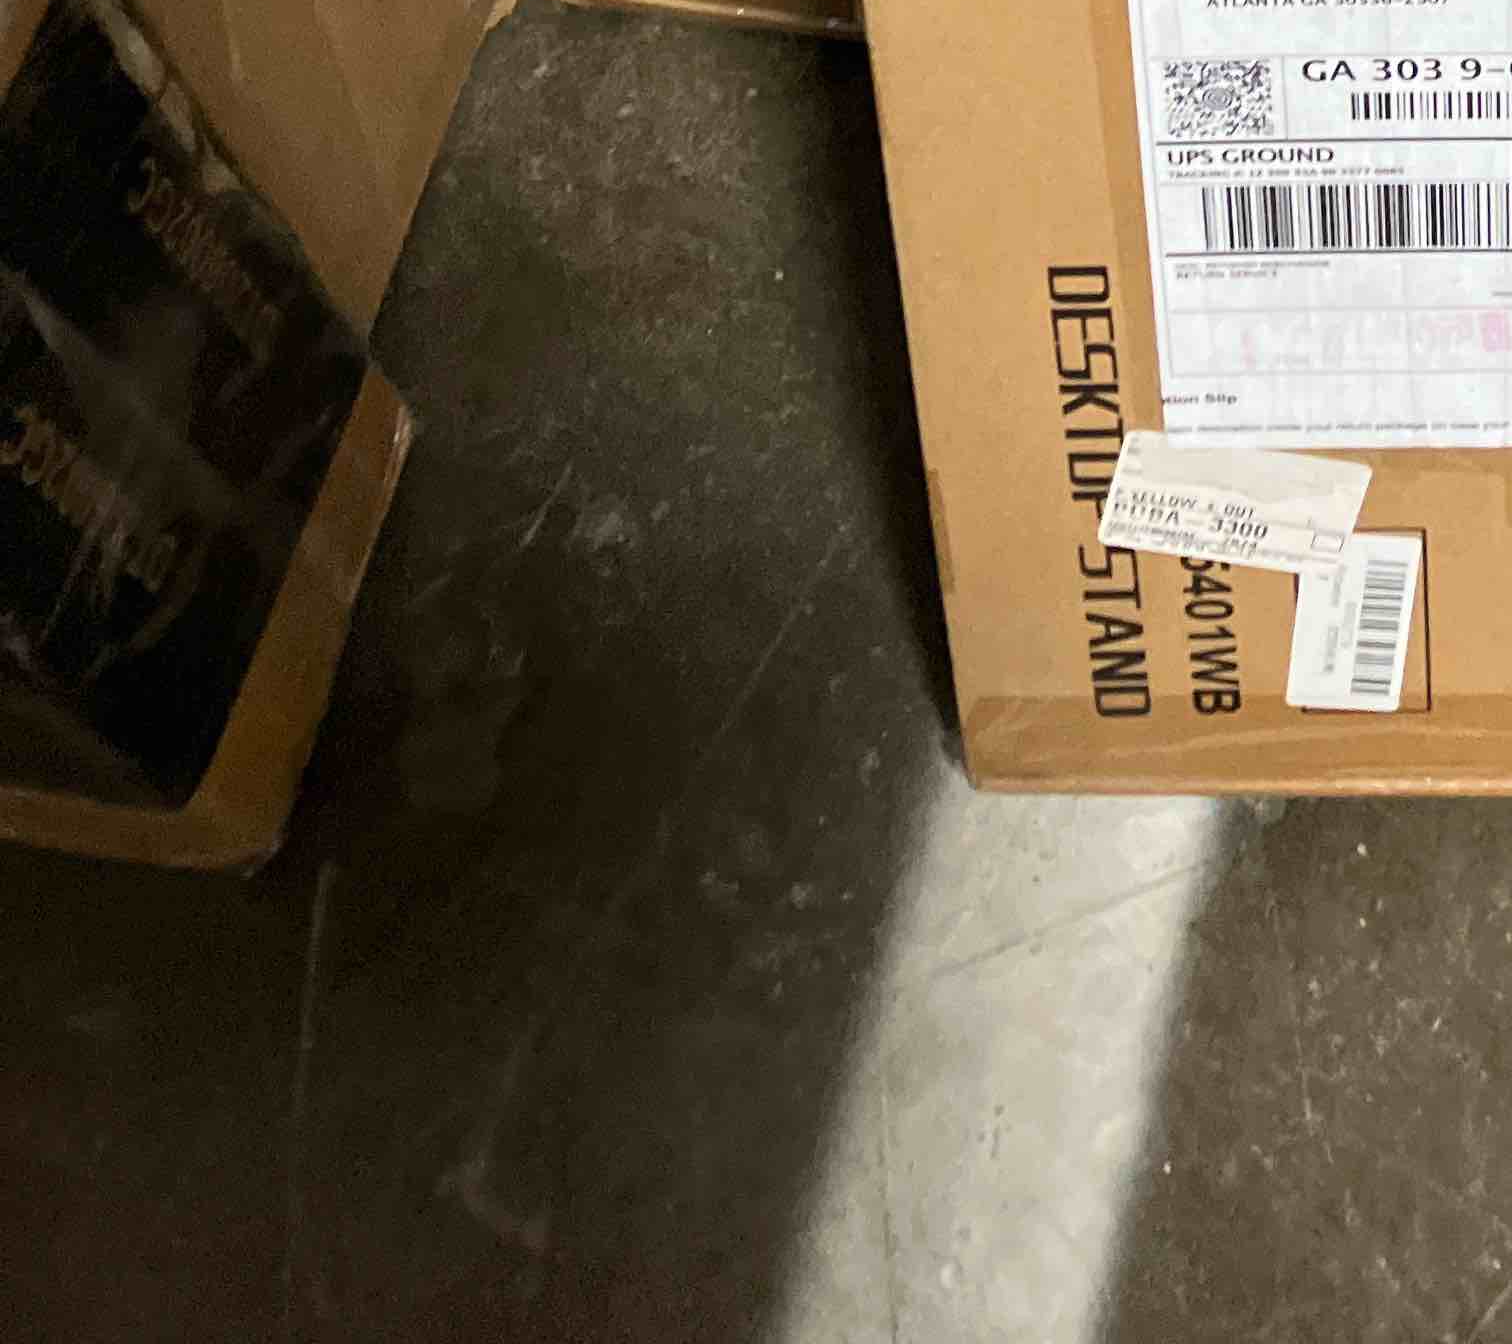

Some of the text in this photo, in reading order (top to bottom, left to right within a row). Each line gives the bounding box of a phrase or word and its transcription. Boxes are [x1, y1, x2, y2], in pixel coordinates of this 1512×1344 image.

[1301, 58, 1356, 83] GA
[1167, 147, 1335, 166] UPS GROUND
[1077, 544, 1152, 719] STAND
[1179, 554, 1243, 718] 5401WB
